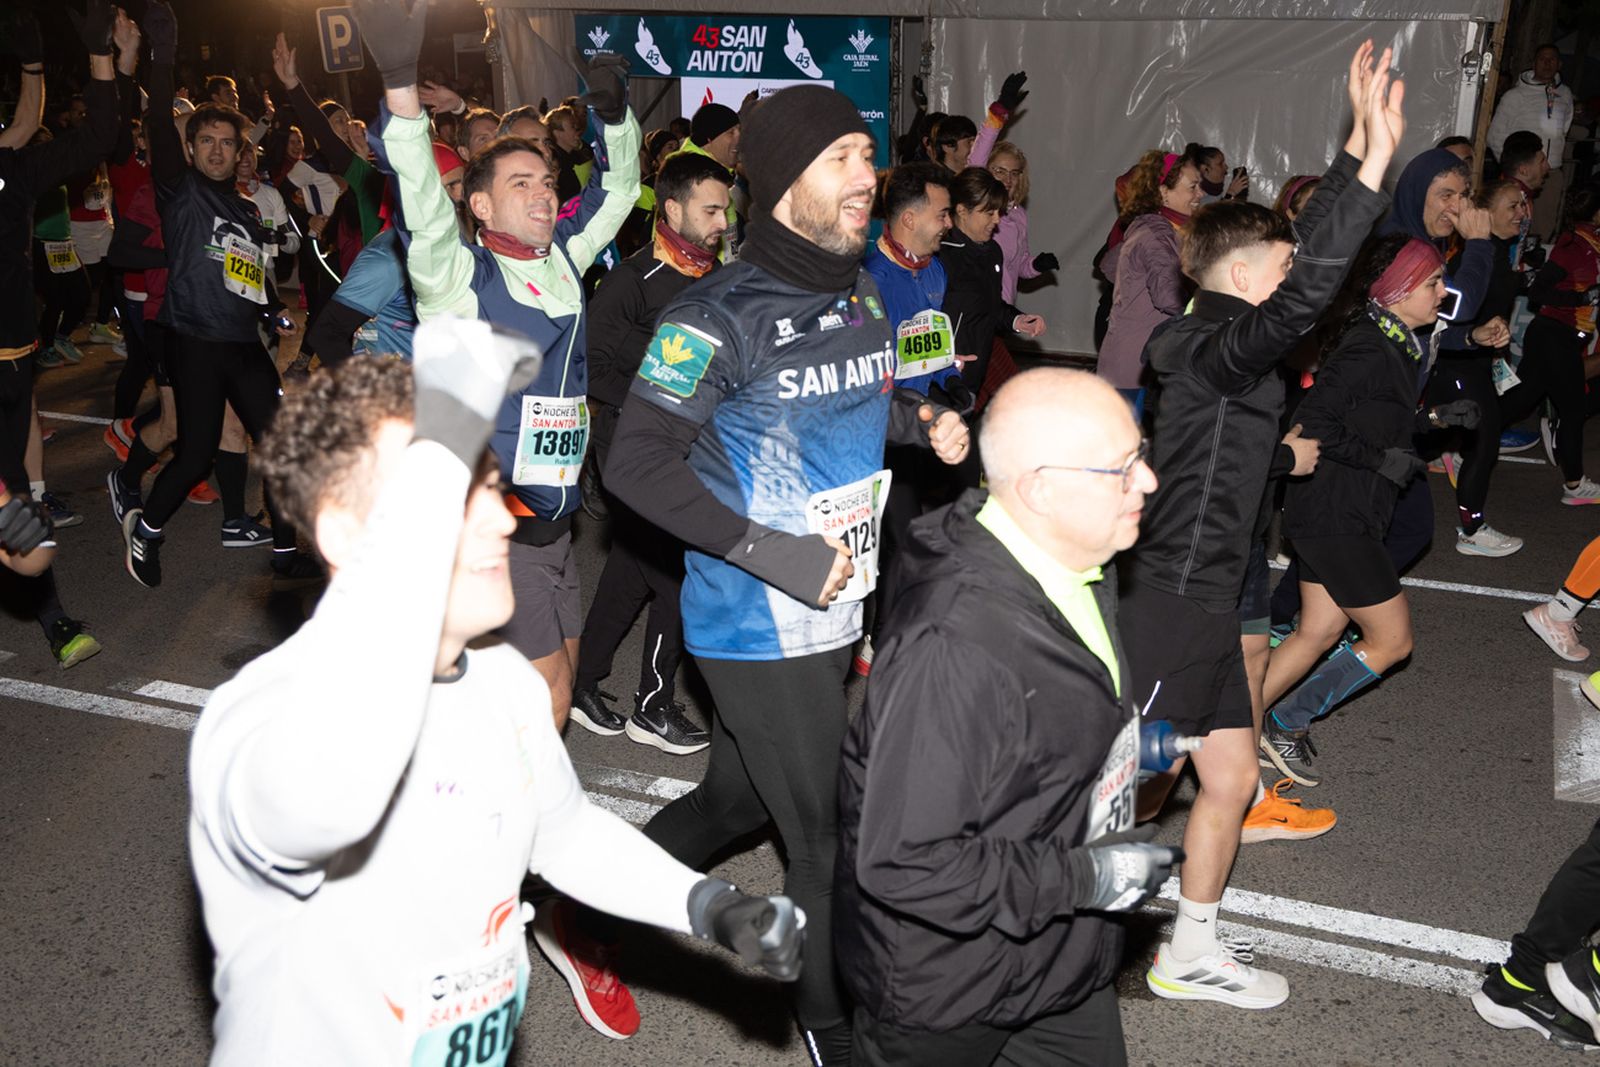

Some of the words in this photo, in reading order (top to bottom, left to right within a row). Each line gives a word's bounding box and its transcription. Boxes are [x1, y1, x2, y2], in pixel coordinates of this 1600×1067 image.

[327, 15, 352, 64] P
[692, 24, 720, 48] 43
[720, 25, 767, 47] SAN
[646, 49, 660, 65] 43
[687, 45, 763, 73] ANTÓN
[795, 52, 811, 69] 43
[857, 109, 884, 119] erón
[230, 256, 262, 285] 12136
[904, 331, 942, 356] 4689
[777, 363, 839, 399] SAN
[845, 341, 895, 390] ANTÓ
[532, 418, 551, 428] SAN
[543, 407, 569, 417] NOCHE
[533, 429, 585, 457] 13897
[835, 495, 860, 512] NOCHE
[823, 516, 845, 531] SAN
[1106, 778, 1136, 833] 55
[427, 1003, 462, 1028] SAN
